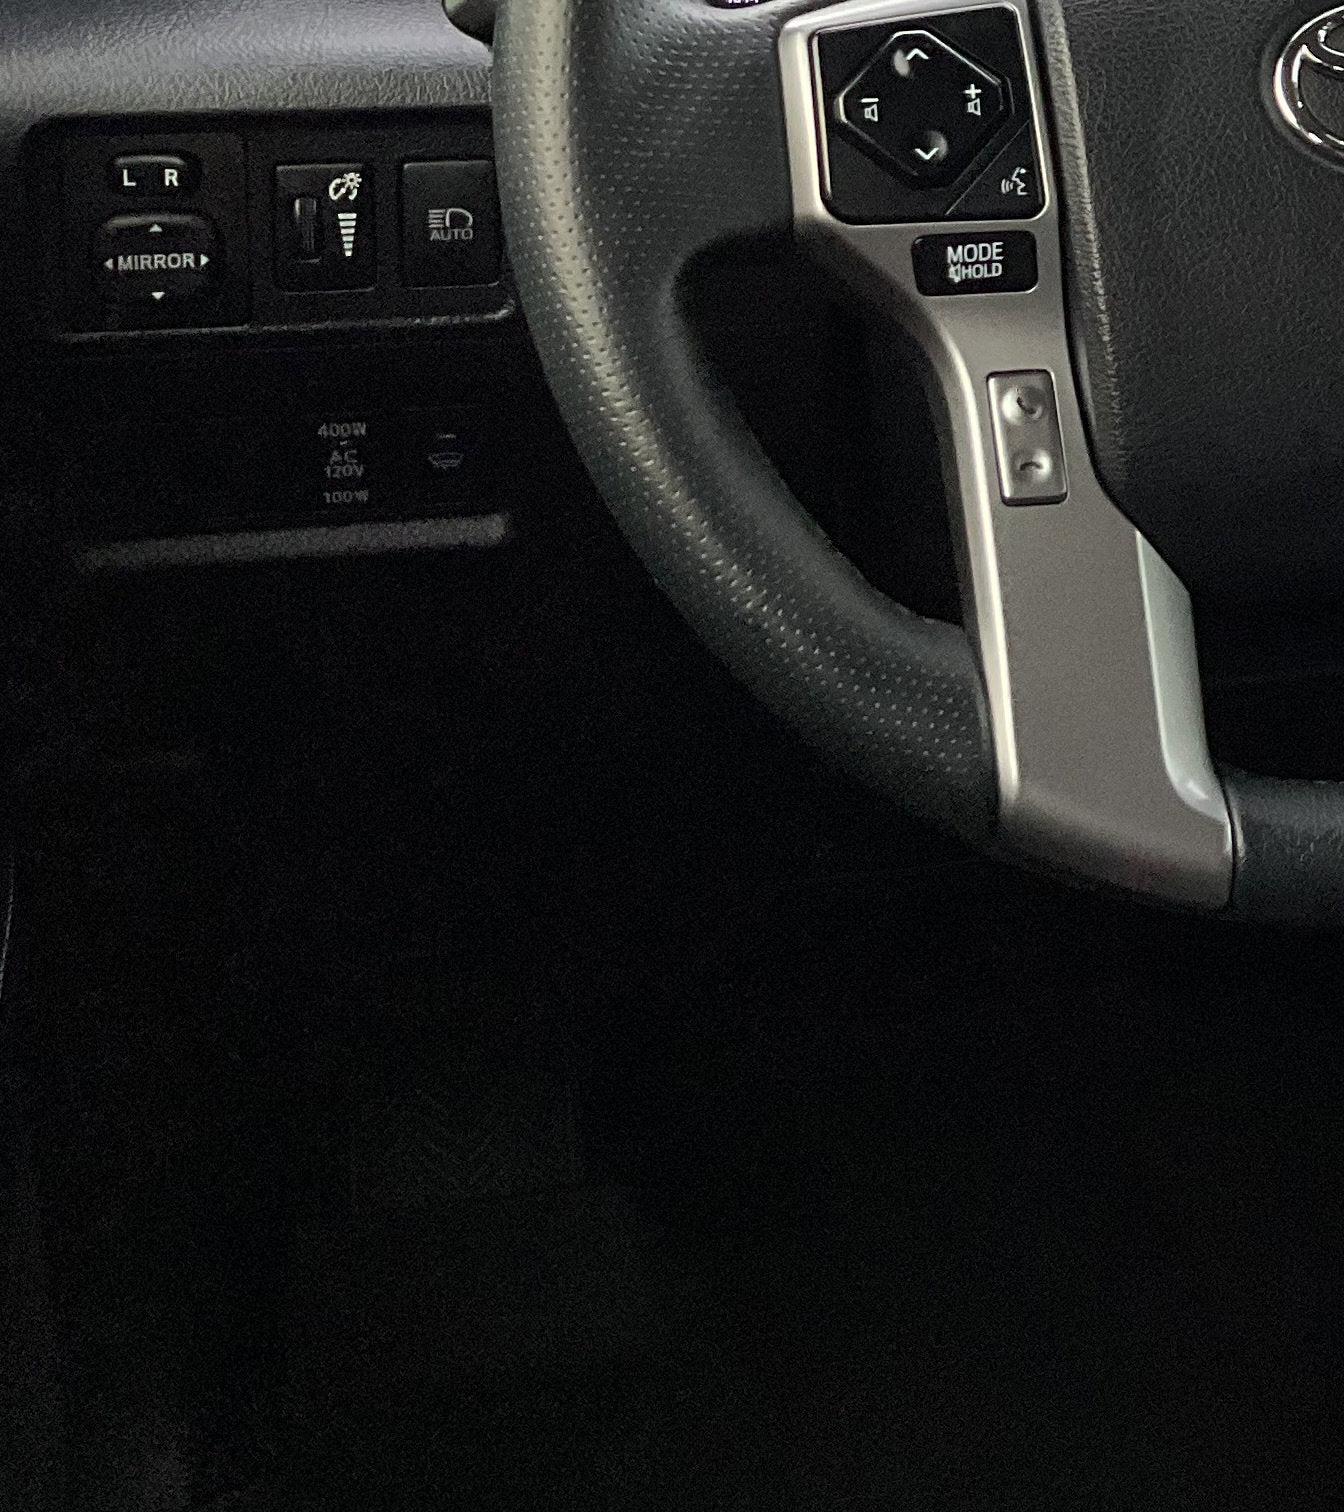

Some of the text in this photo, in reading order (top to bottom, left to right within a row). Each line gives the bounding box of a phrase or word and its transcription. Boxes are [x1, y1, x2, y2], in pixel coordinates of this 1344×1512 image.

[122, 169, 179, 187] L R
[429, 227, 474, 242] AUTO
[946, 241, 1005, 263] MODE
[117, 252, 196, 272] MIRROR
[961, 262, 1003, 280] HOLD
[317, 421, 367, 438] 400W
[329, 449, 358, 465] AC
[323, 464, 365, 479] 120V
